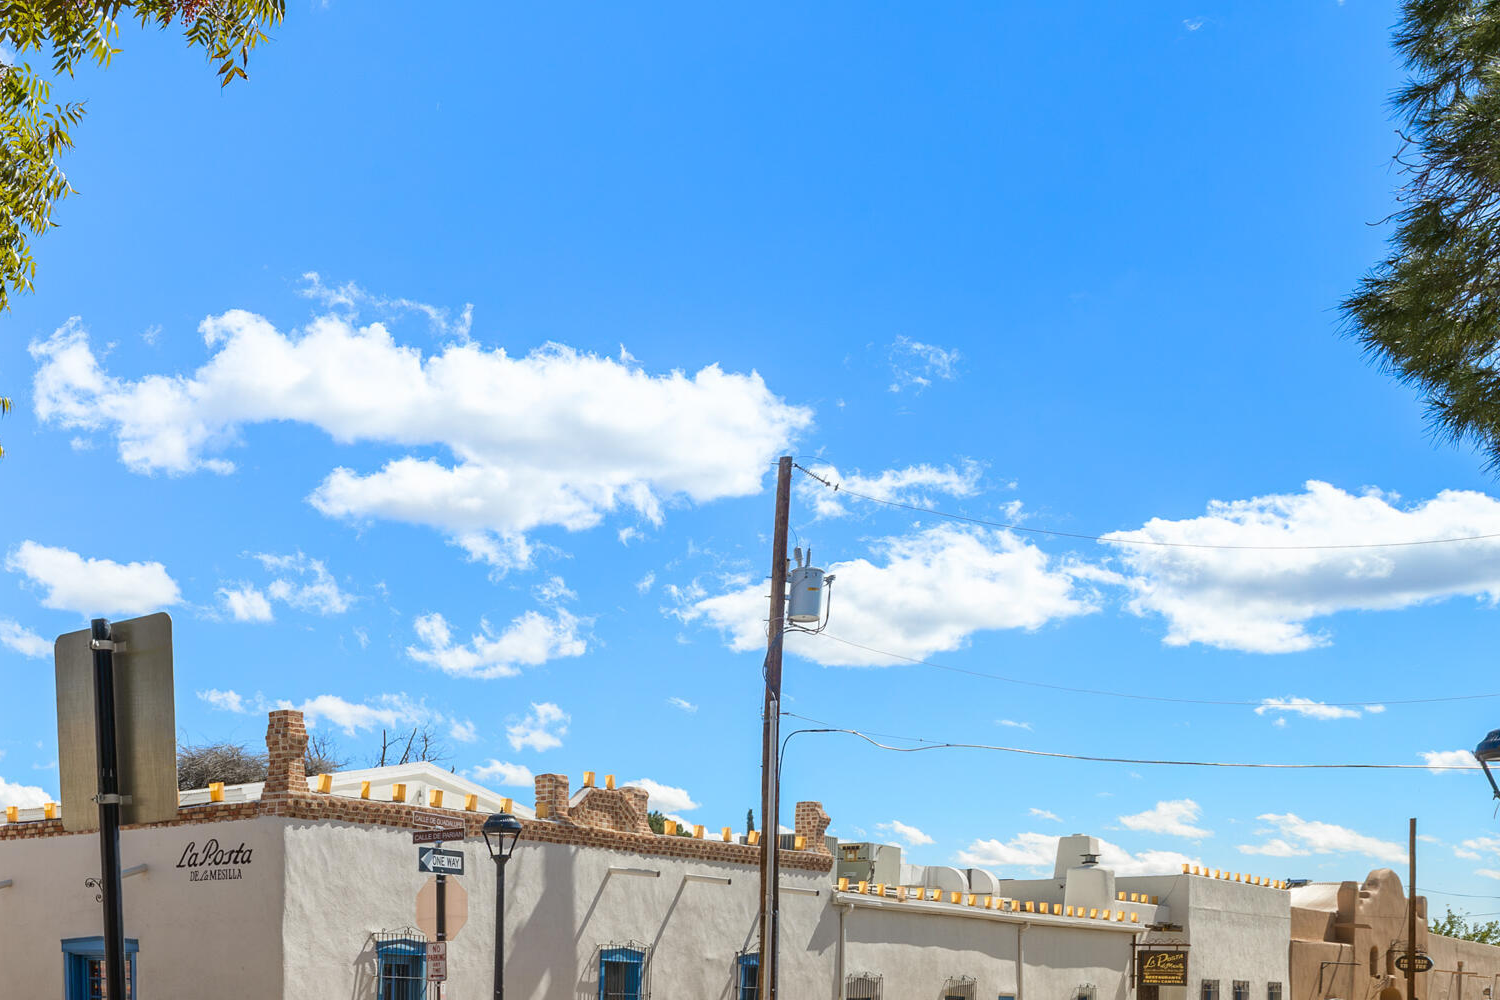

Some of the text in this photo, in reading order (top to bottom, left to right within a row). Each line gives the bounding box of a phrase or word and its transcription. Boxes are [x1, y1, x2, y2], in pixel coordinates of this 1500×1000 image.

[415, 814, 429, 824] CALLE
[415, 833, 432, 841] CALLE
[442, 831, 463, 839] PARIAN
[176, 838, 253, 868] La Posta
[432, 856, 460, 868] ONE WAY
[190, 870, 199, 881] DE
[209, 868, 242, 881] MESILLA
[433, 944, 441, 953] NO
